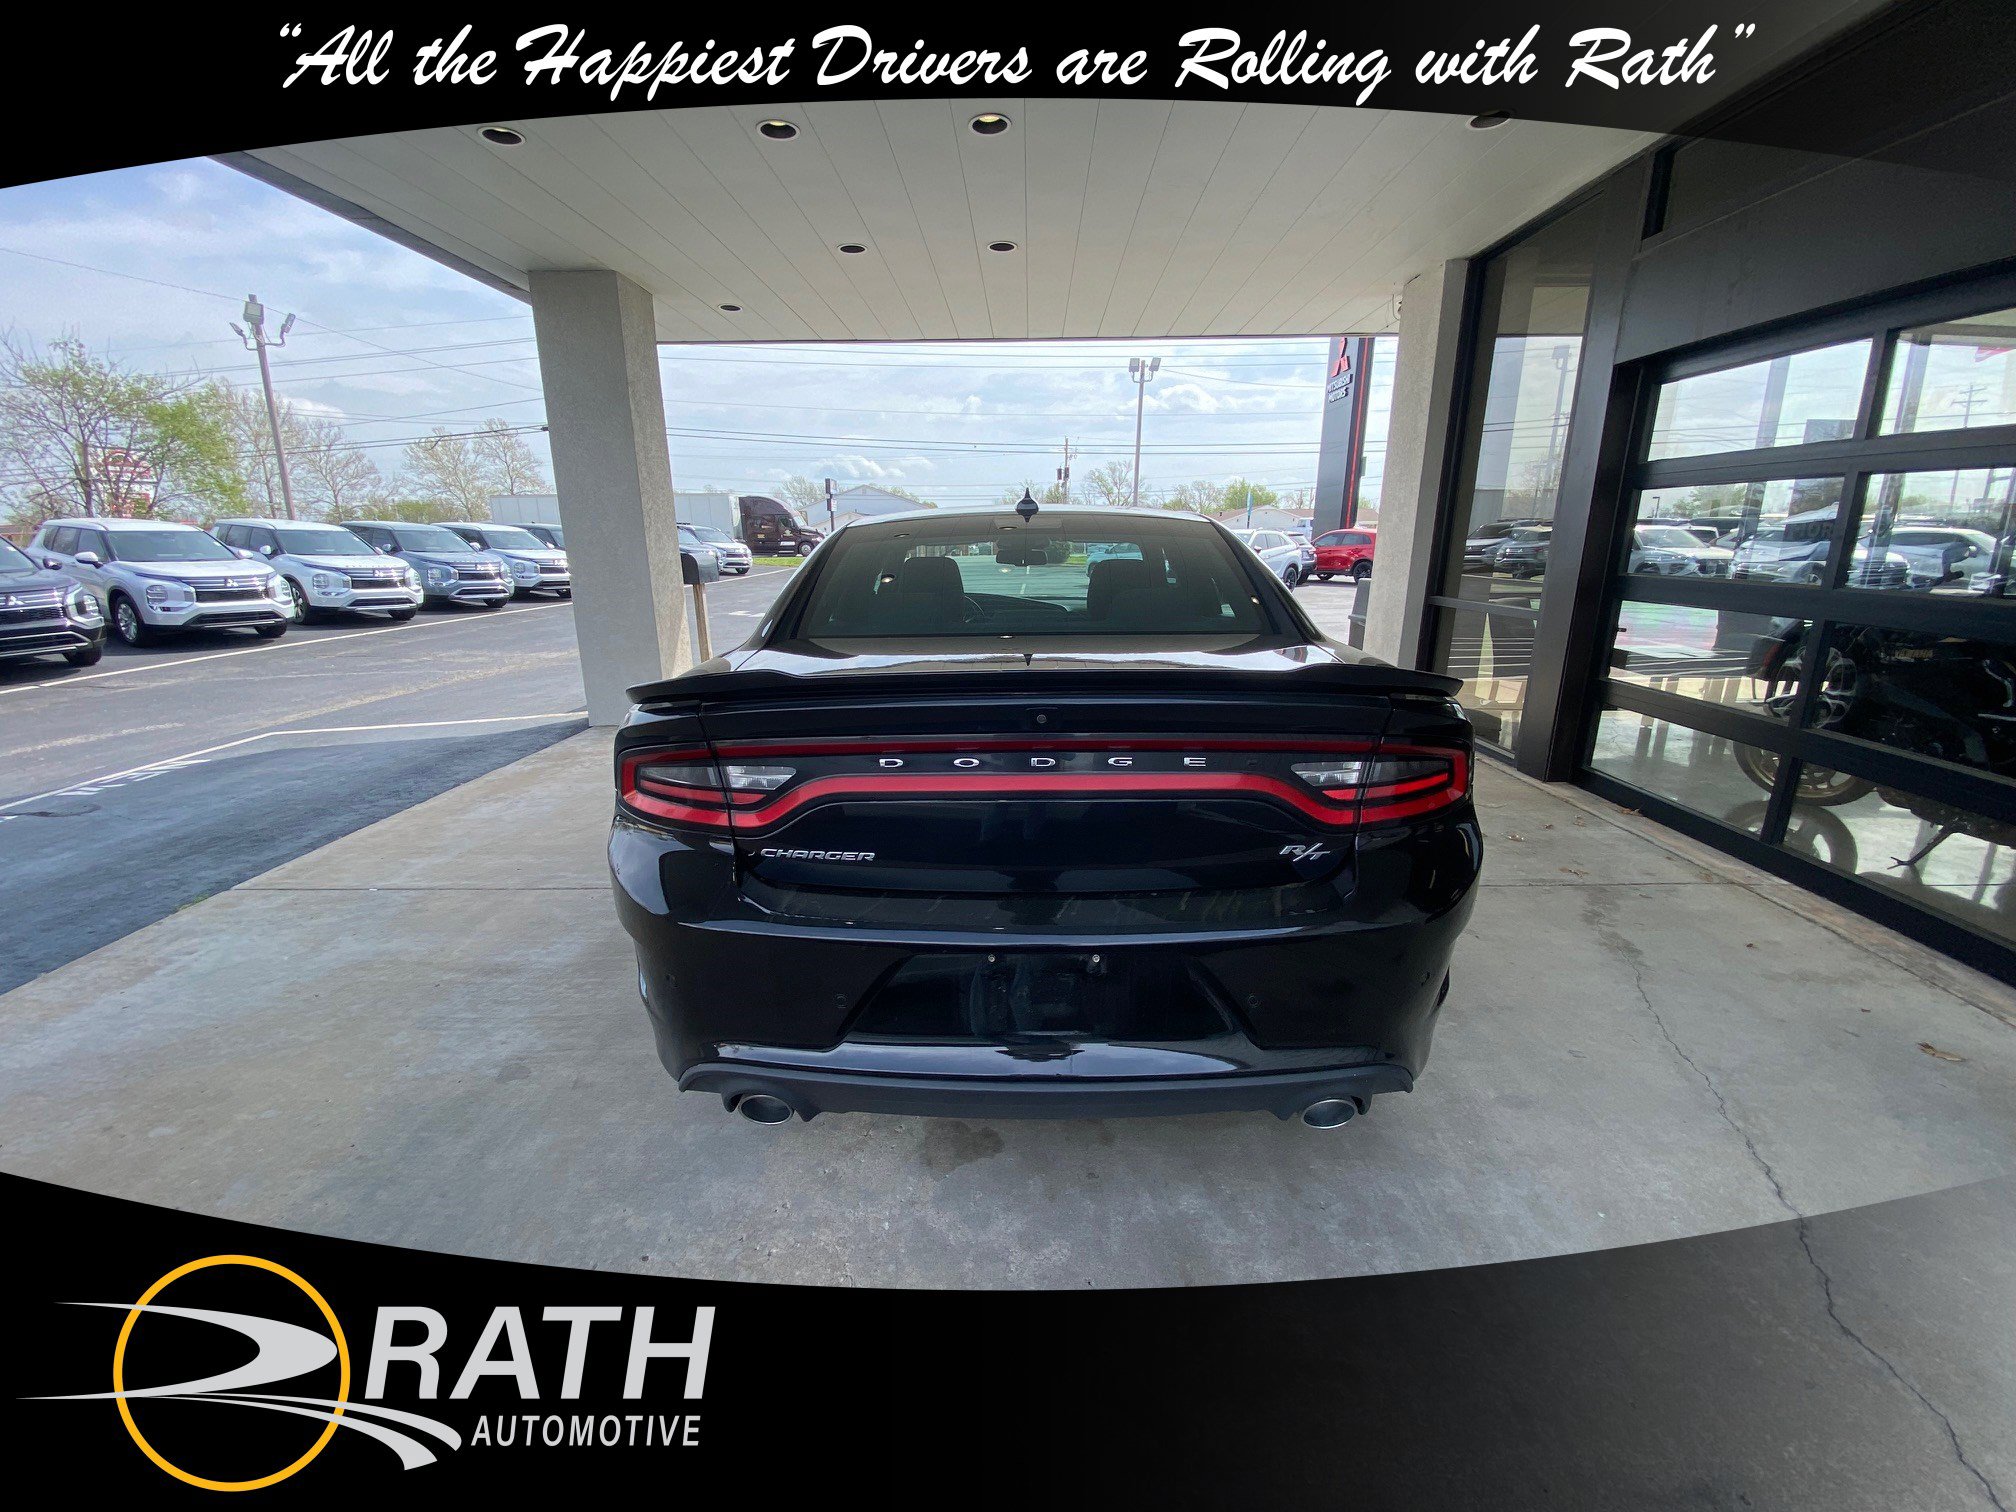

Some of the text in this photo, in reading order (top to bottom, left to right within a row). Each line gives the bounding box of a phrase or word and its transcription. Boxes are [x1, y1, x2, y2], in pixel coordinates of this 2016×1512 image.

[878, 756, 1207, 768] DODGE
[760, 848, 876, 861] CHARGER
[1279, 842, 1331, 862] R/T
